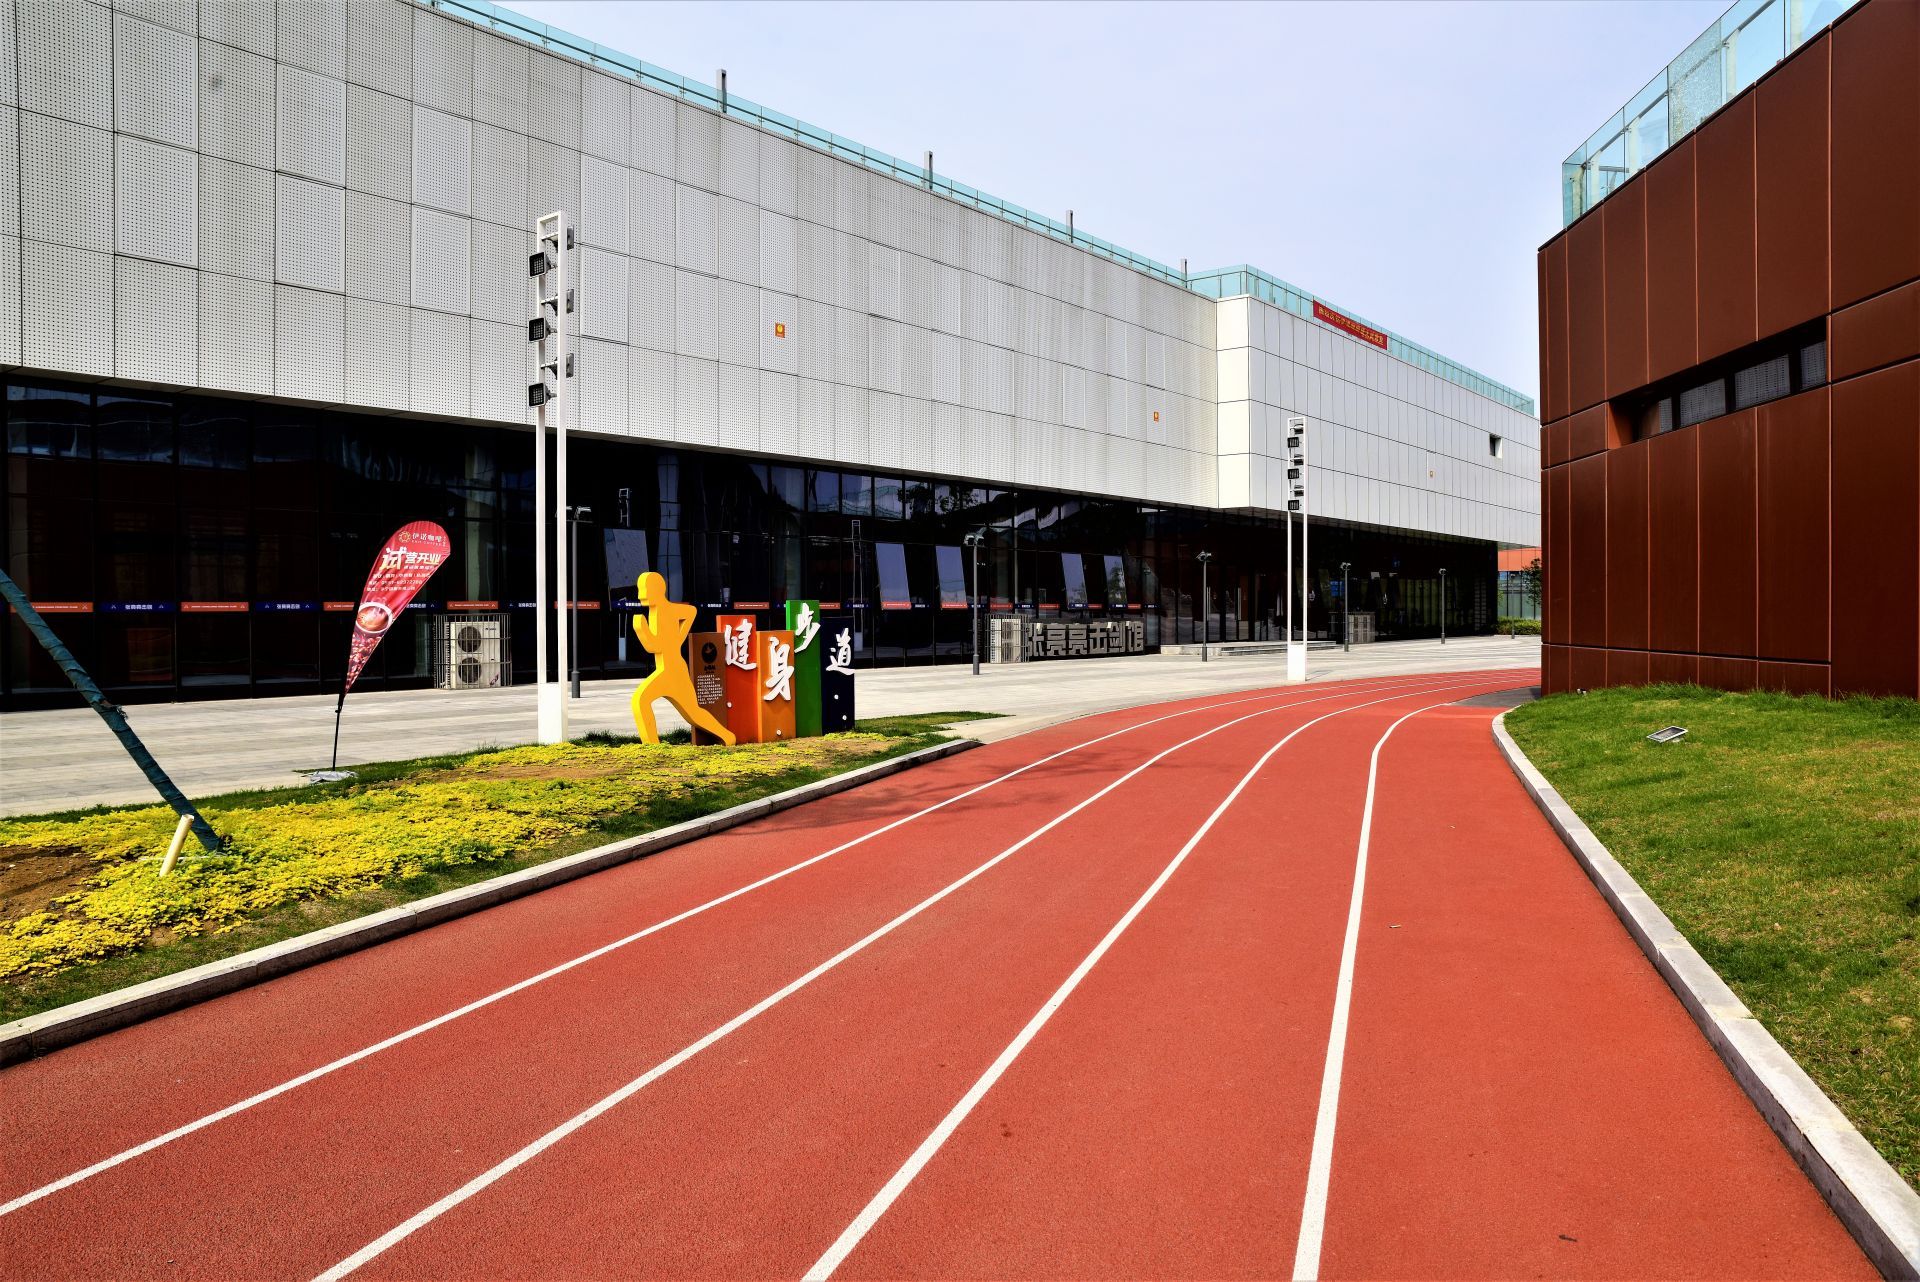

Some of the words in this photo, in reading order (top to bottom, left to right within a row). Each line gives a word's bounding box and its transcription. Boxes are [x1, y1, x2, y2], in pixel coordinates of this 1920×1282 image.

[379, 546, 442, 570] 试营开业
[1024, 621, 1144, 657] 张亮亮击剑馆
